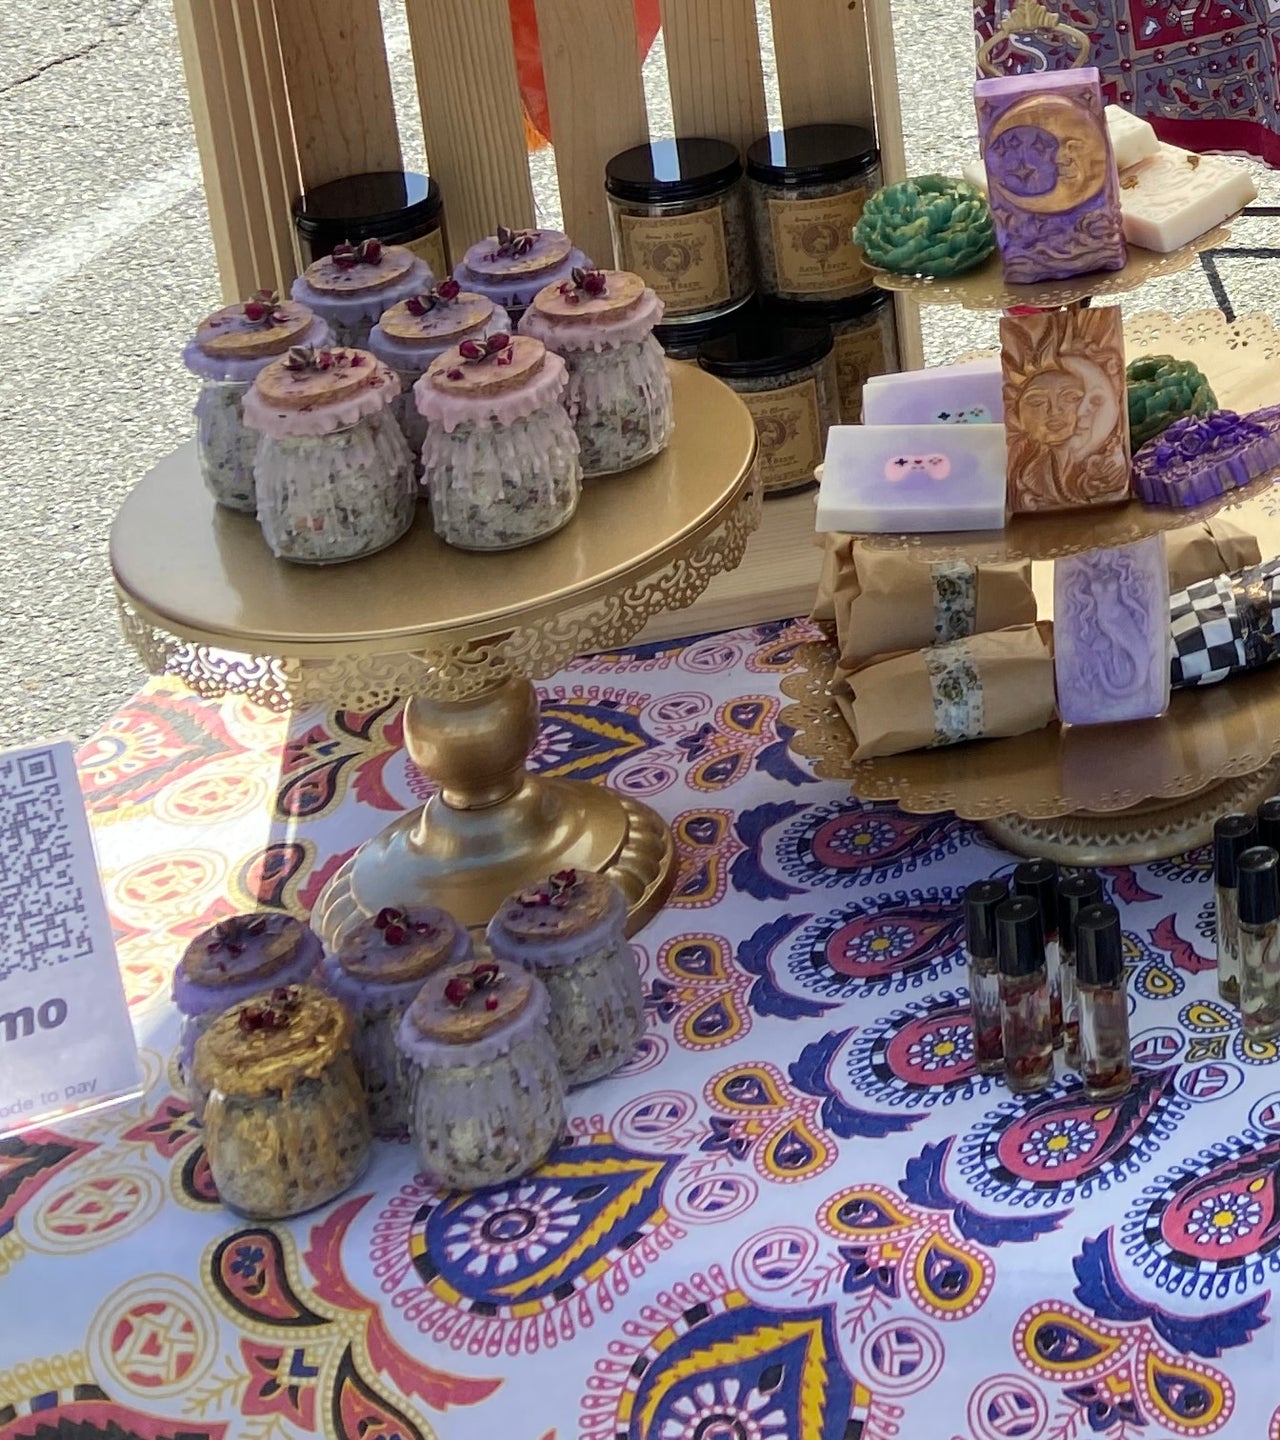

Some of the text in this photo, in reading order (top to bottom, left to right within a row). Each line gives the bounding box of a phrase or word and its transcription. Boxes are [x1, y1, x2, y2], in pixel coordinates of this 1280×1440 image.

[0, 998, 67, 1041] mo
[0, 1079, 97, 1118] ode to pay
